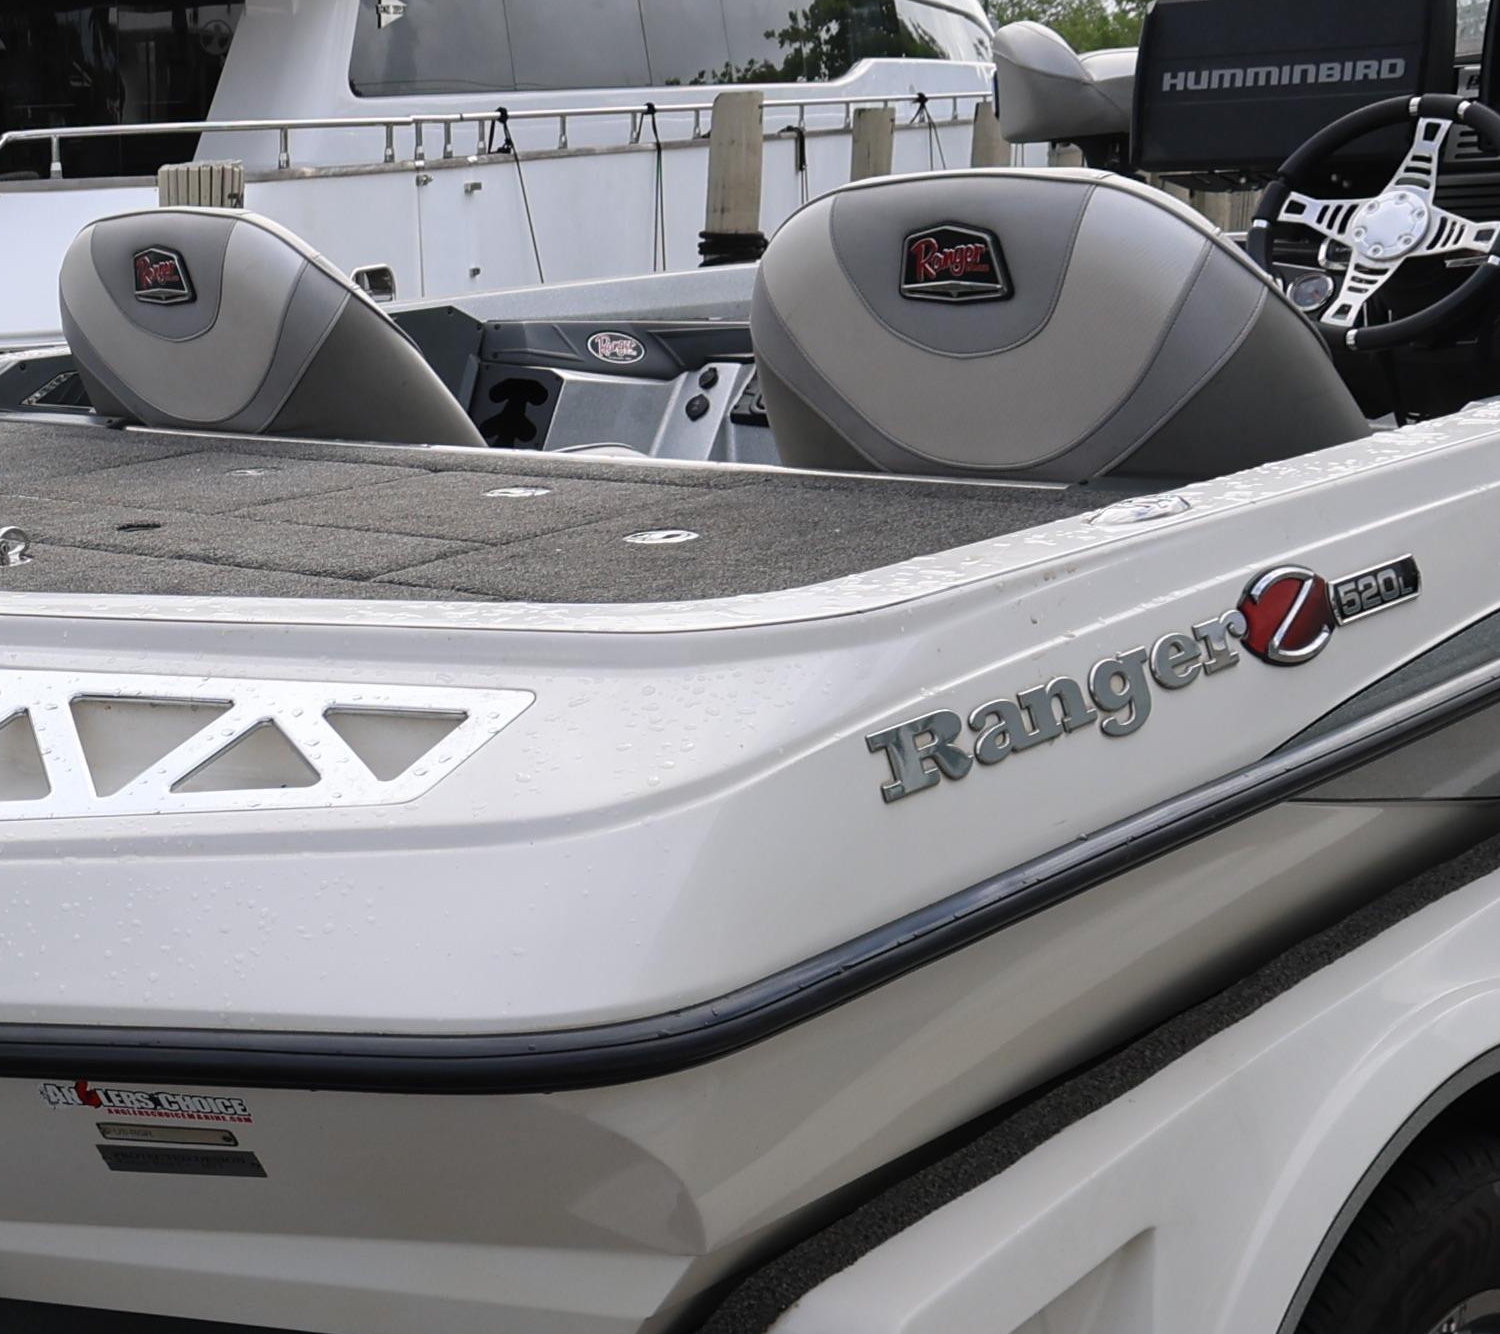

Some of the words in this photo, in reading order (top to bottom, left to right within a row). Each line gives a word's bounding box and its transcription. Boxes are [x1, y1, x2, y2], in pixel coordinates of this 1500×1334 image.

[1162, 58, 1406, 92] HUMMINBIRD
[911, 237, 986, 282] Ranger
[864, 607, 1248, 804] Ranger
[1338, 568, 1412, 617] 520L
[156, 1092, 251, 1116] CHOICE
